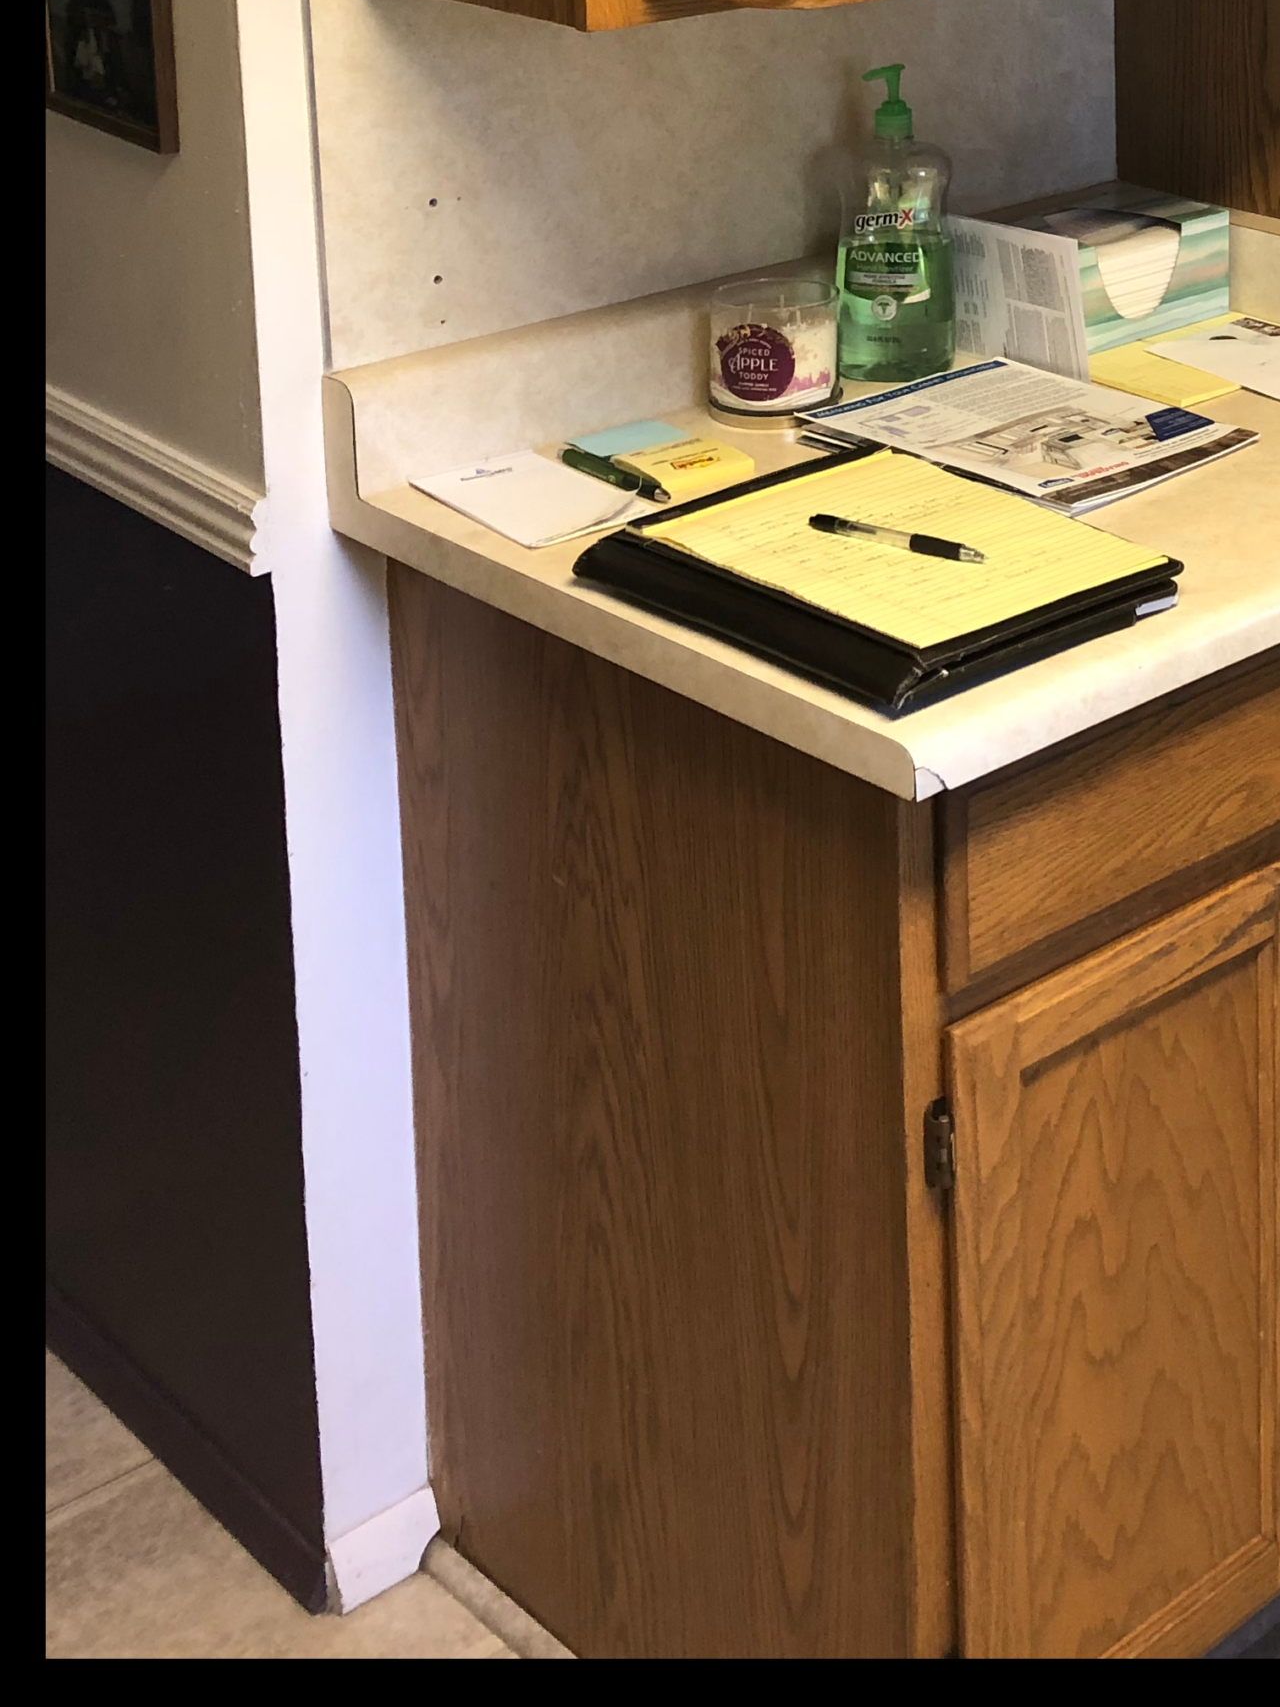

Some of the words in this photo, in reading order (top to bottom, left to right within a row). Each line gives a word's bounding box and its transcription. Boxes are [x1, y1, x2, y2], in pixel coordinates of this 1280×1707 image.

[849, 249, 921, 263] ADVANCED
[738, 347, 771, 356] SPICED
[728, 354, 779, 374] APPLE
[739, 372, 769, 380] TODDY
